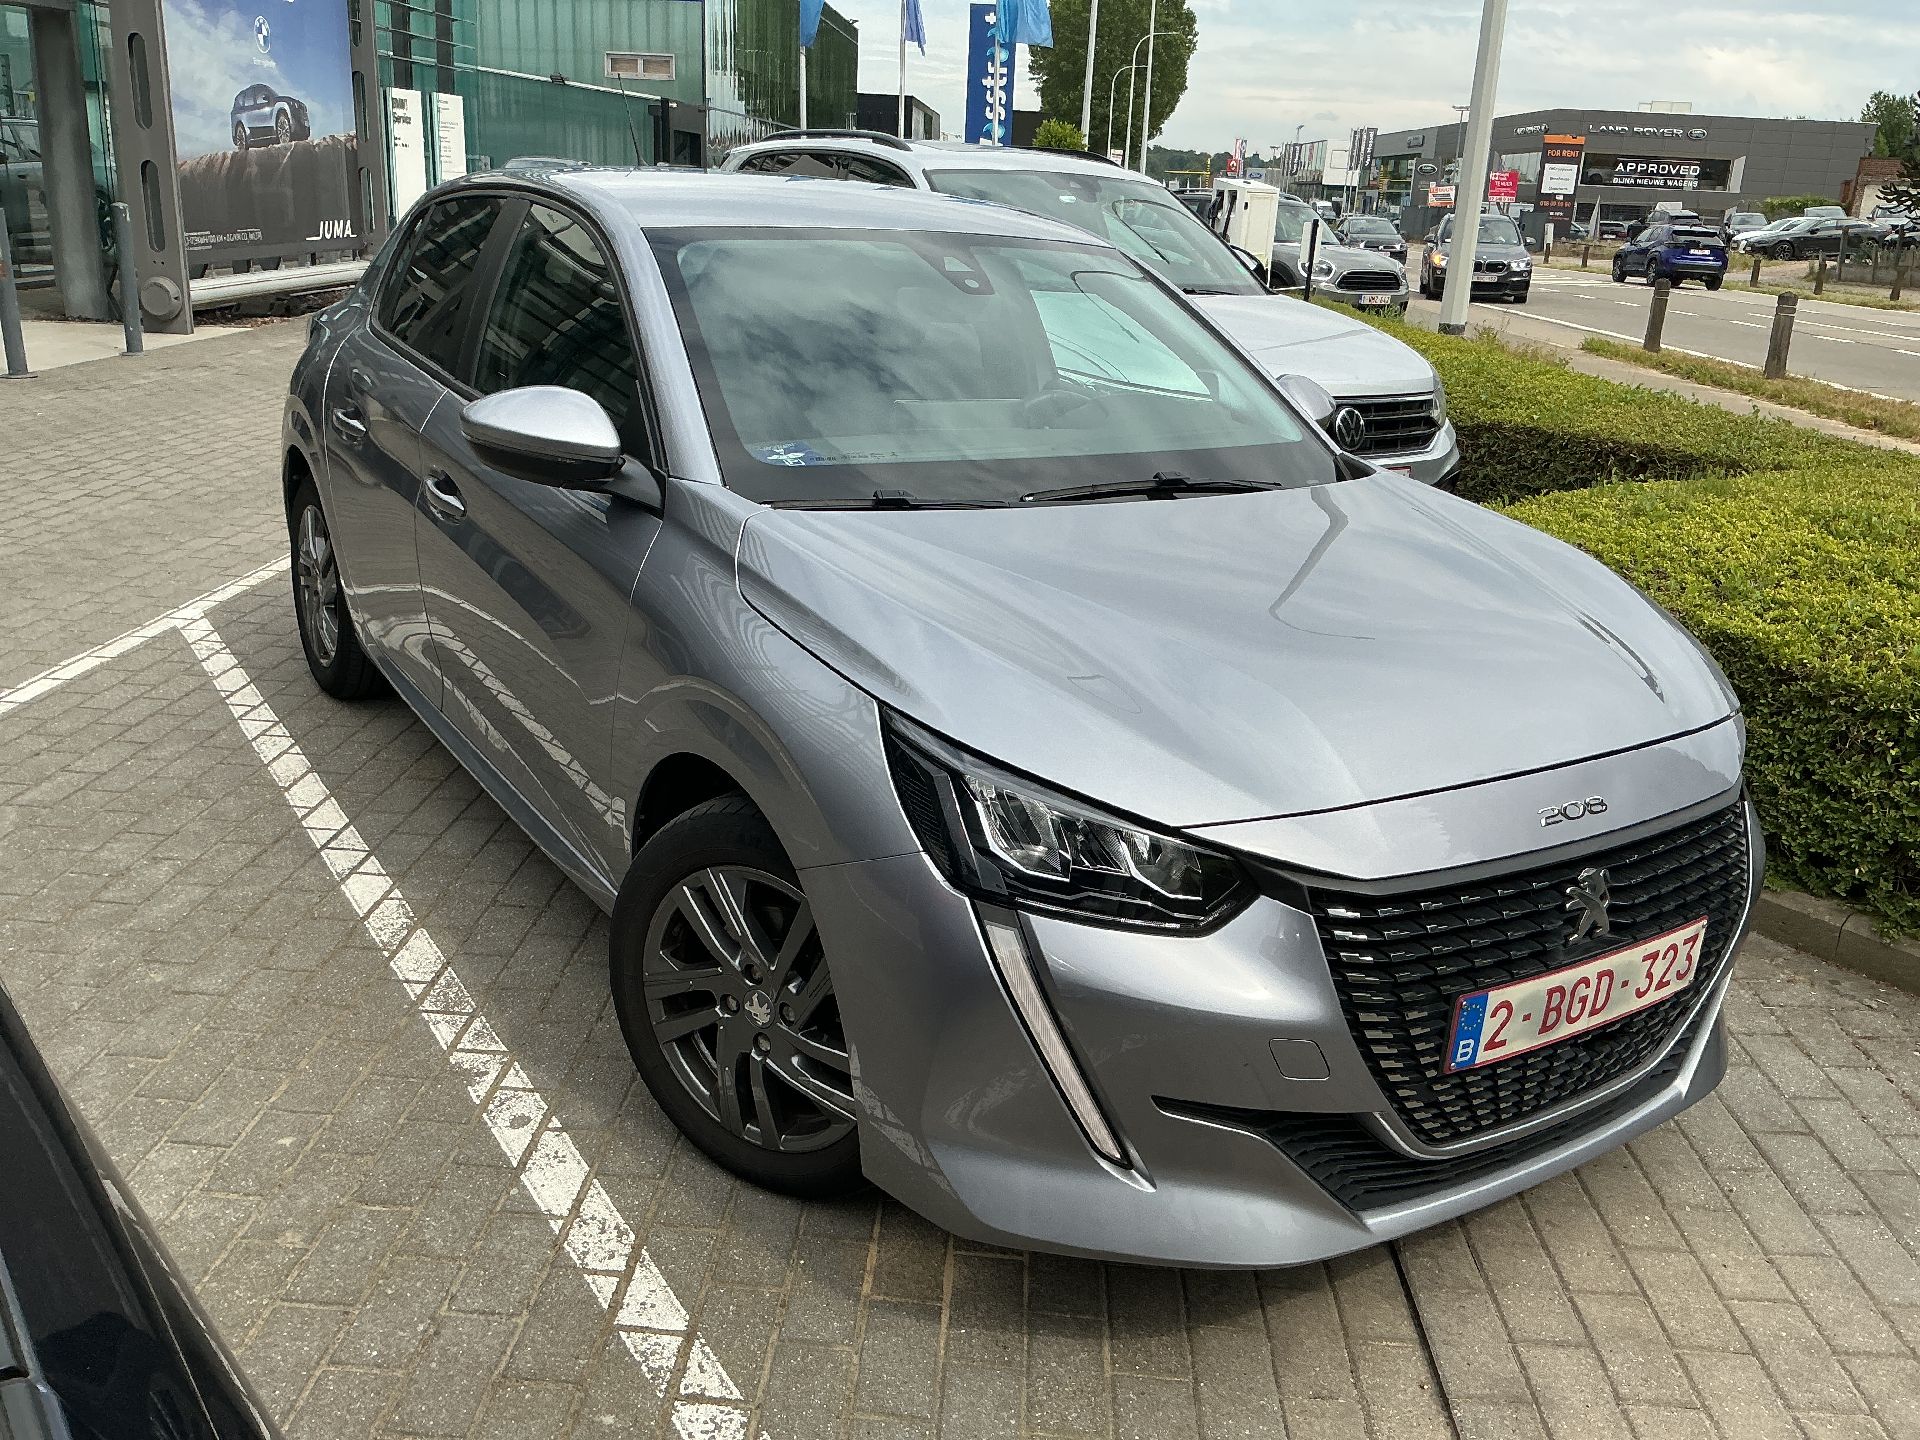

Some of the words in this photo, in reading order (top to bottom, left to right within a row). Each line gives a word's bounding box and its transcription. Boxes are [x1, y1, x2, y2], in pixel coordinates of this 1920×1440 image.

[1589, 124, 1629, 134] LAND
[1634, 127, 1683, 137] ROVER
[1547, 149, 1561, 157] FOR
[1562, 150, 1580, 158] RENT
[1614, 162, 1700, 176] APPROVED
[1637, 178, 1665, 187] NIEUWE
[1666, 179, 1699, 188] WAGENS
[307, 219, 357, 241] JUMA
[1537, 796, 1608, 828] 208
[1456, 1038, 1474, 1062] B
[1483, 933, 1700, 1052] 2-BGD-323
